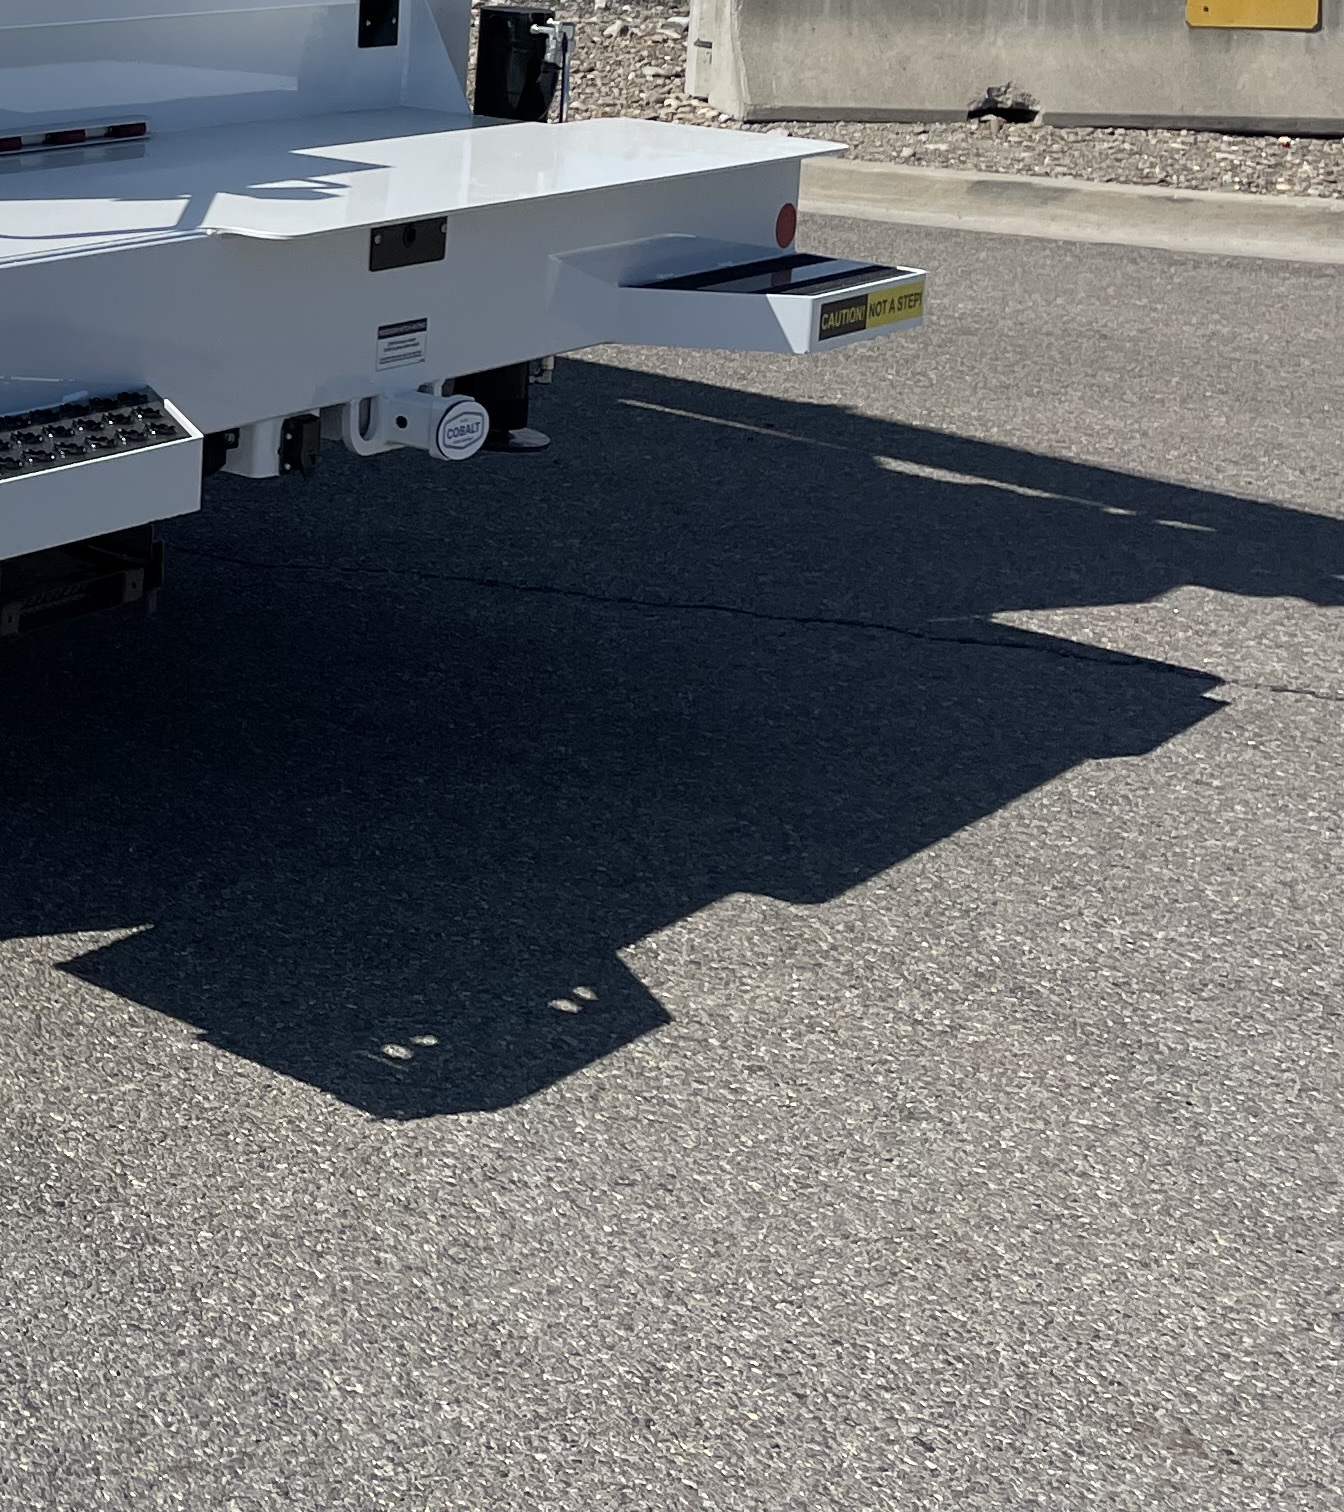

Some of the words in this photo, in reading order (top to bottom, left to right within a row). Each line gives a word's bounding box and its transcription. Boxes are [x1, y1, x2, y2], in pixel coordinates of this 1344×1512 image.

[869, 299, 888, 317] NOT
[888, 297, 896, 313] A
[446, 421, 481, 439] COBALT
